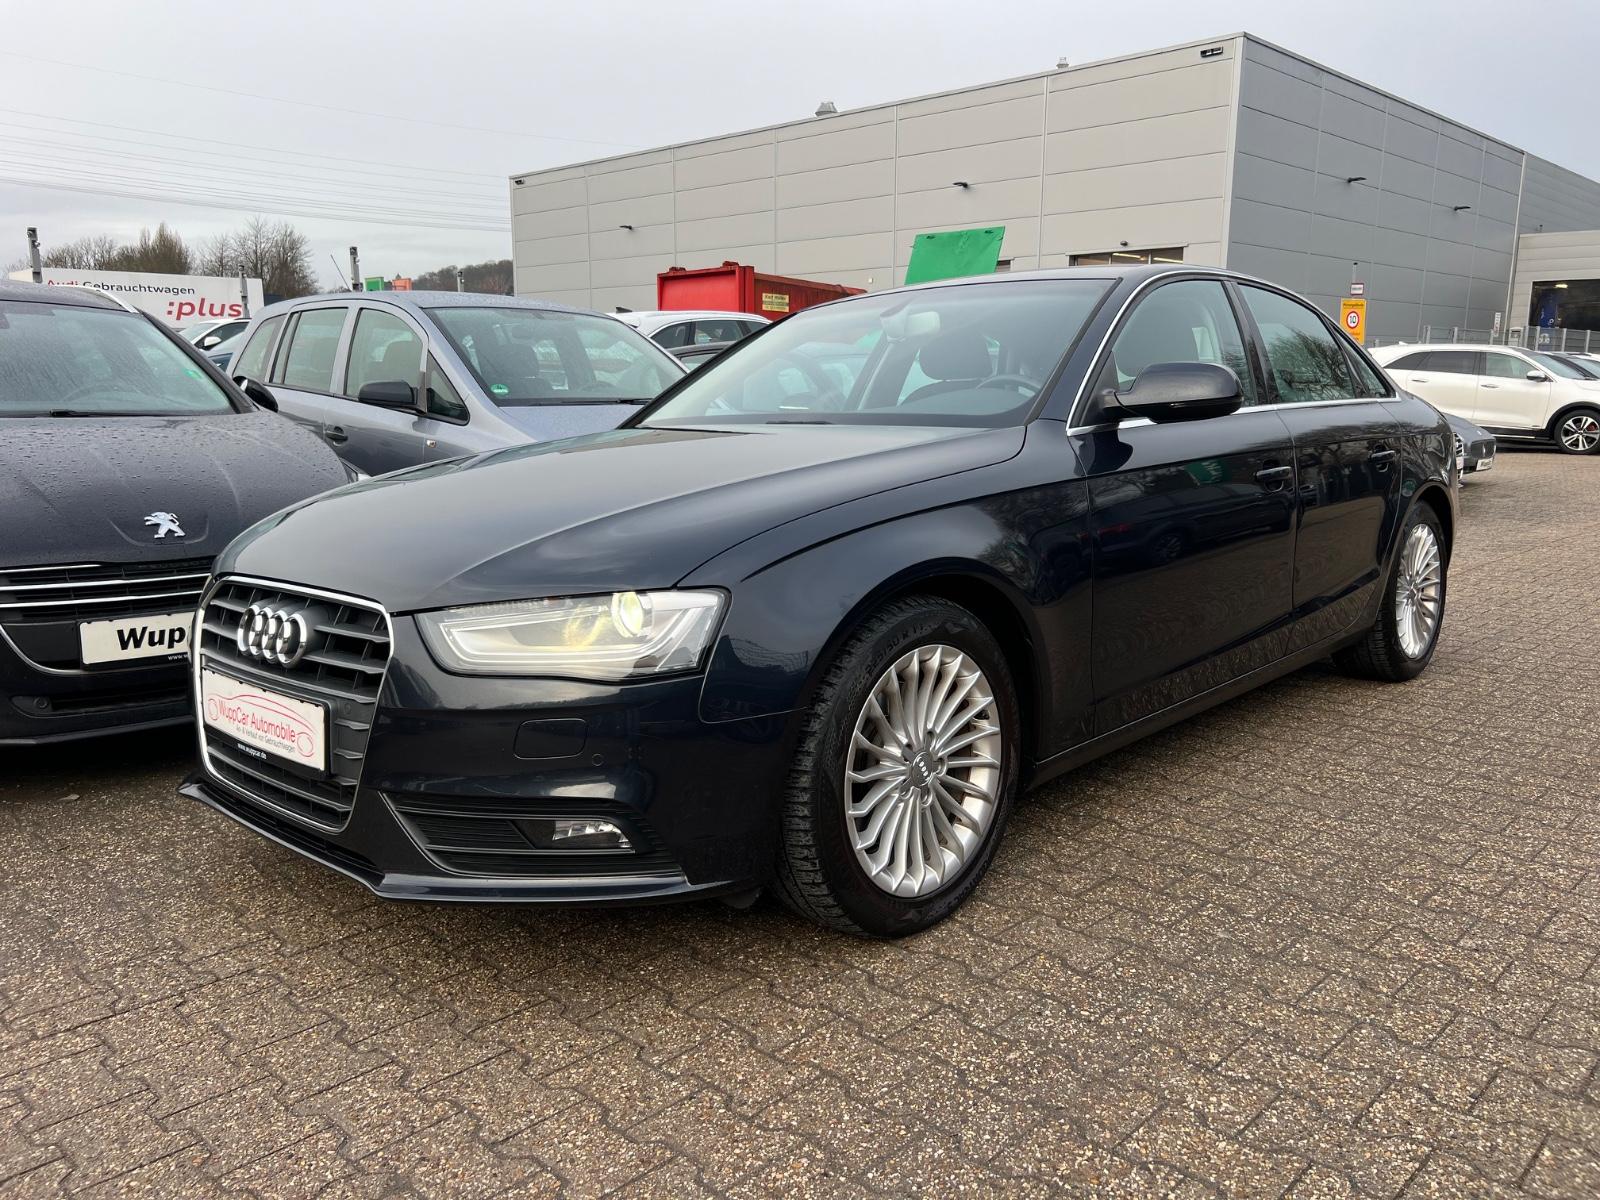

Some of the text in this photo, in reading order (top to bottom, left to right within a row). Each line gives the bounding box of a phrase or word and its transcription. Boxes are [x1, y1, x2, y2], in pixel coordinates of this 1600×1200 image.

[117, 626, 186, 650] Wup
[220, 700, 296, 743] WuppCar Automobile
